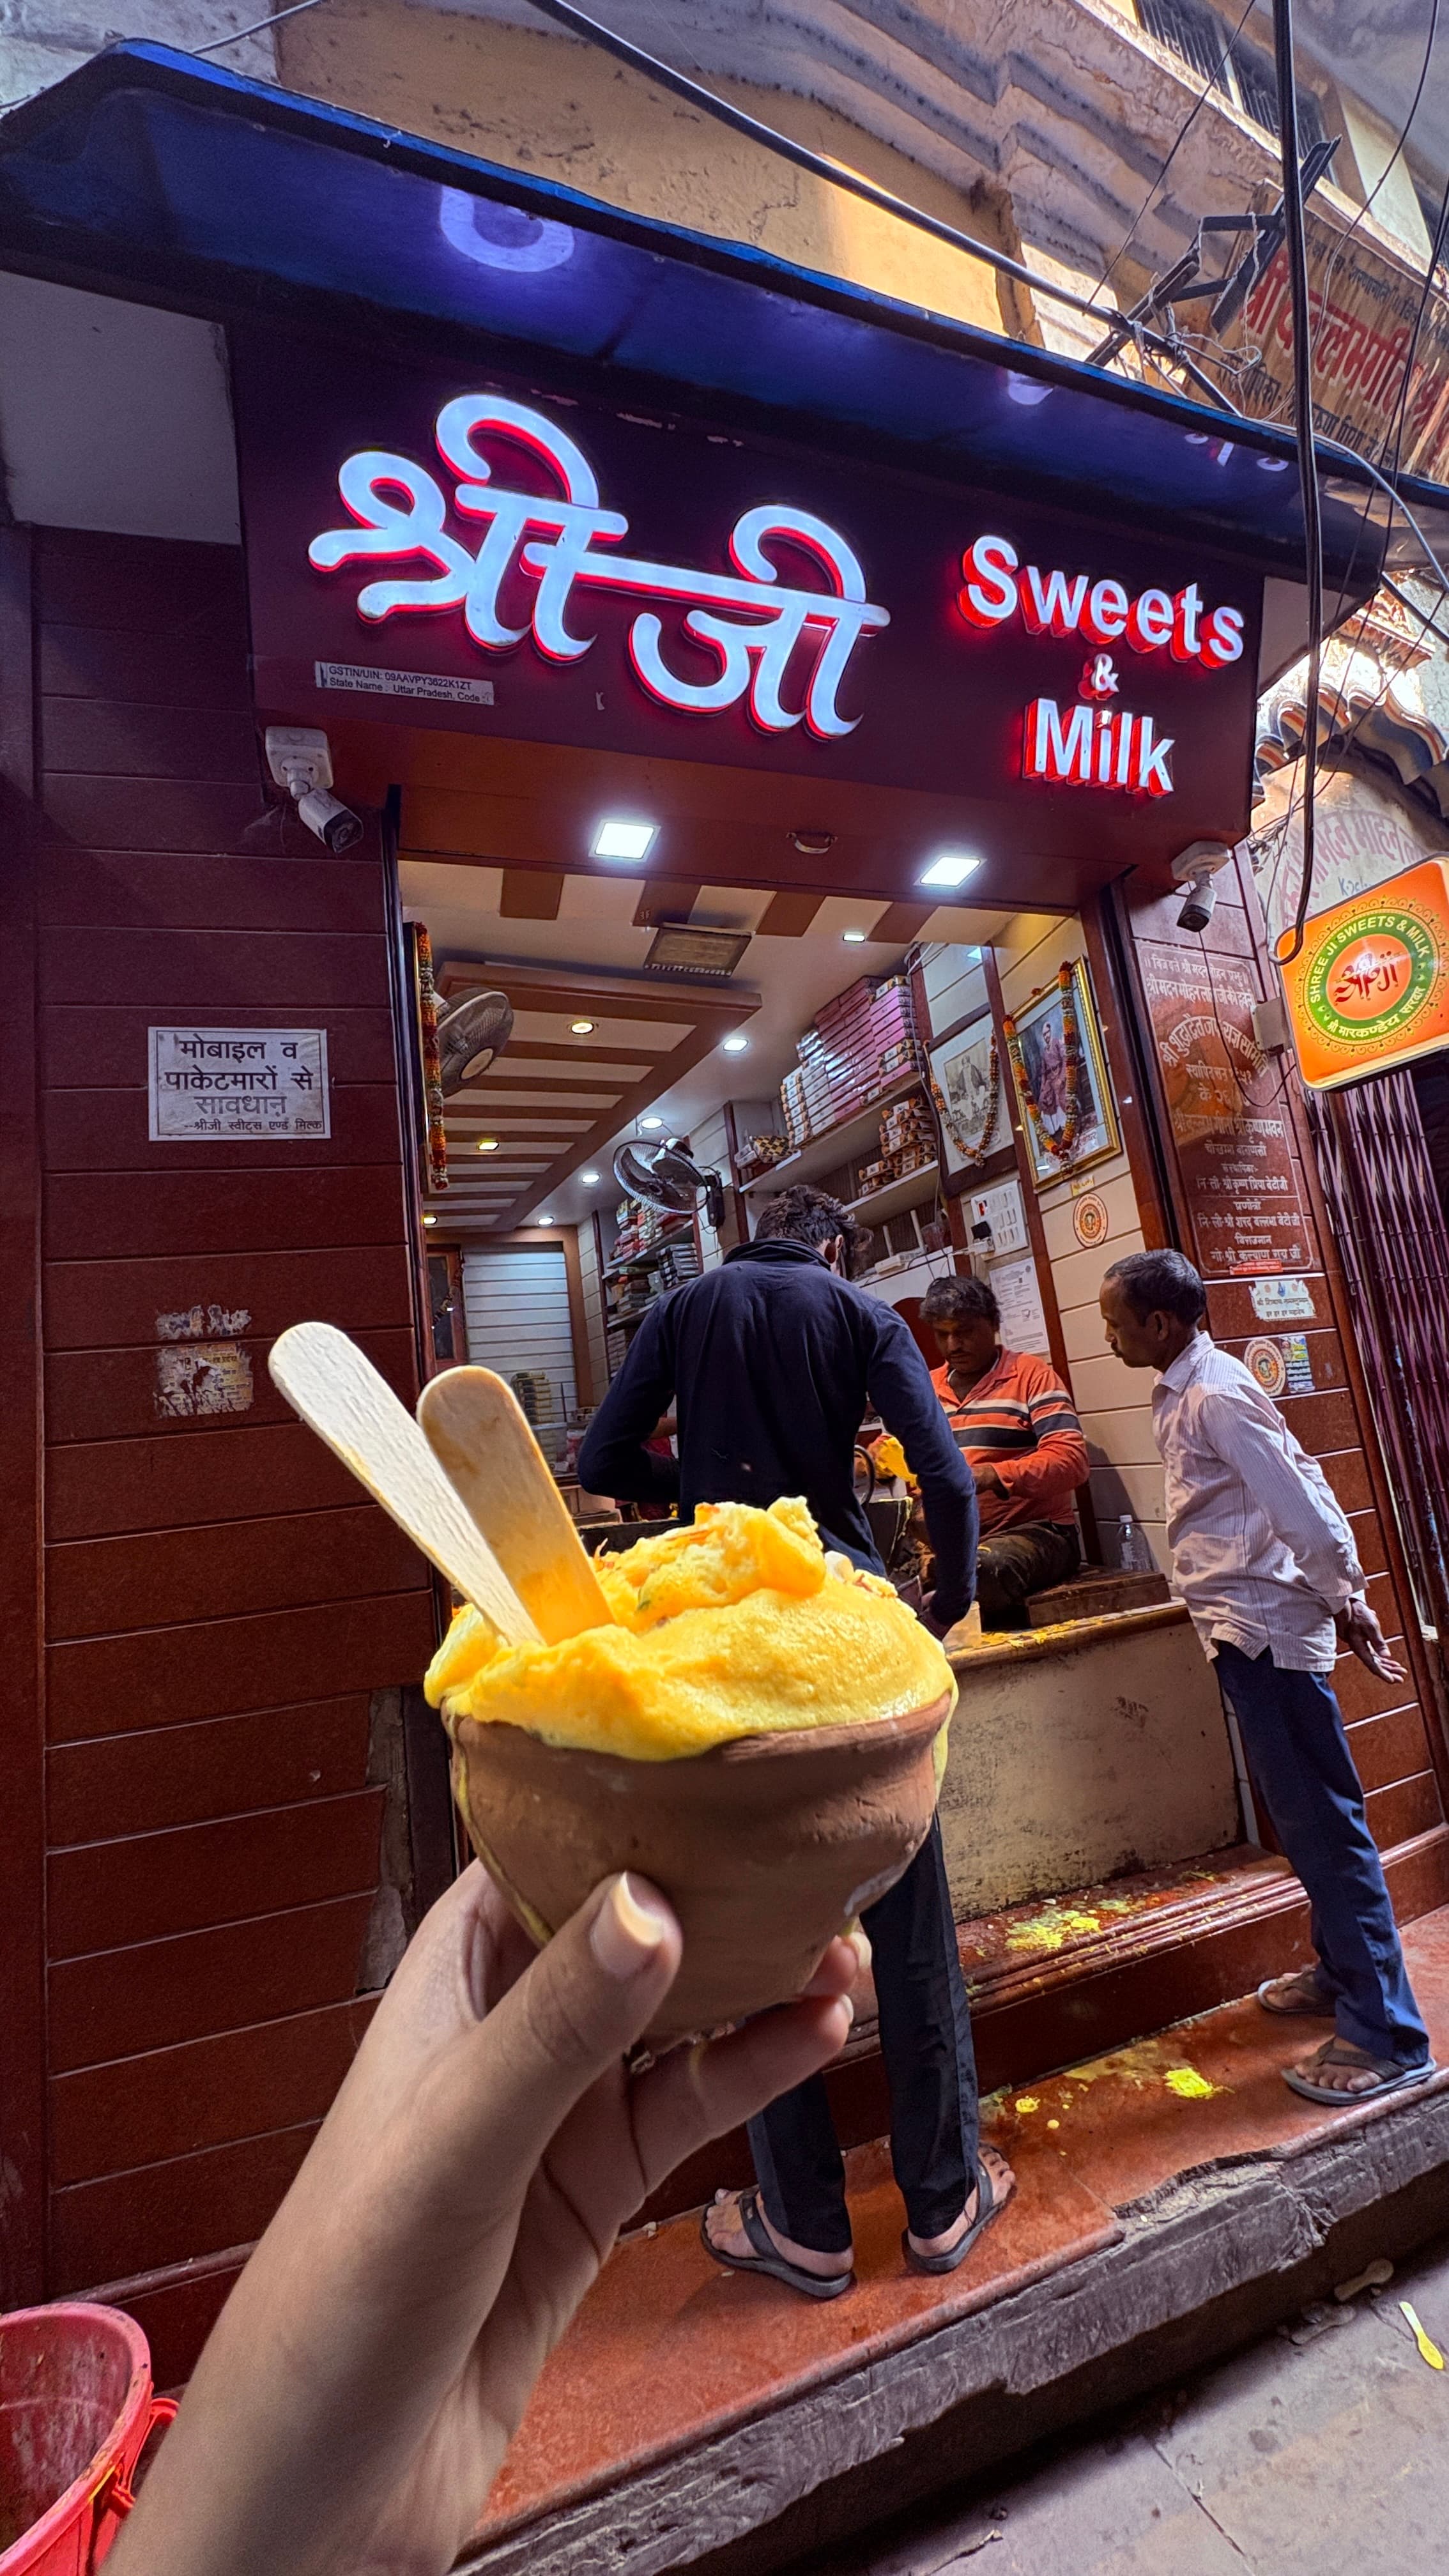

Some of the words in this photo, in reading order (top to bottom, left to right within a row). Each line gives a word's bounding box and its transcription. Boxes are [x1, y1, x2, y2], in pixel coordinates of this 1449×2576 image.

[958, 535, 1244, 669] Sweets
[330, 678, 353, 688] State
[393, 684, 414, 695] Uttar
[1078, 653, 1119, 701] &
[1023, 698, 1175, 797] Milk
[1310, 956, 1329, 1004] SHREE
[1326, 942, 1338, 956] JI
[1337, 916, 1395, 944] SWEETS
[1397, 919, 1407, 932] &
[1406, 925, 1430, 958] MILK
[1327, 1019, 1340, 1034] श्री
[179, 1033, 266, 1063] मोबाइल
[280, 1041, 298, 1060] व
[164, 1064, 278, 1091] पाकेटमारों
[289, 1066, 314, 1091] से
[194, 1094, 288, 1117] सावधान
